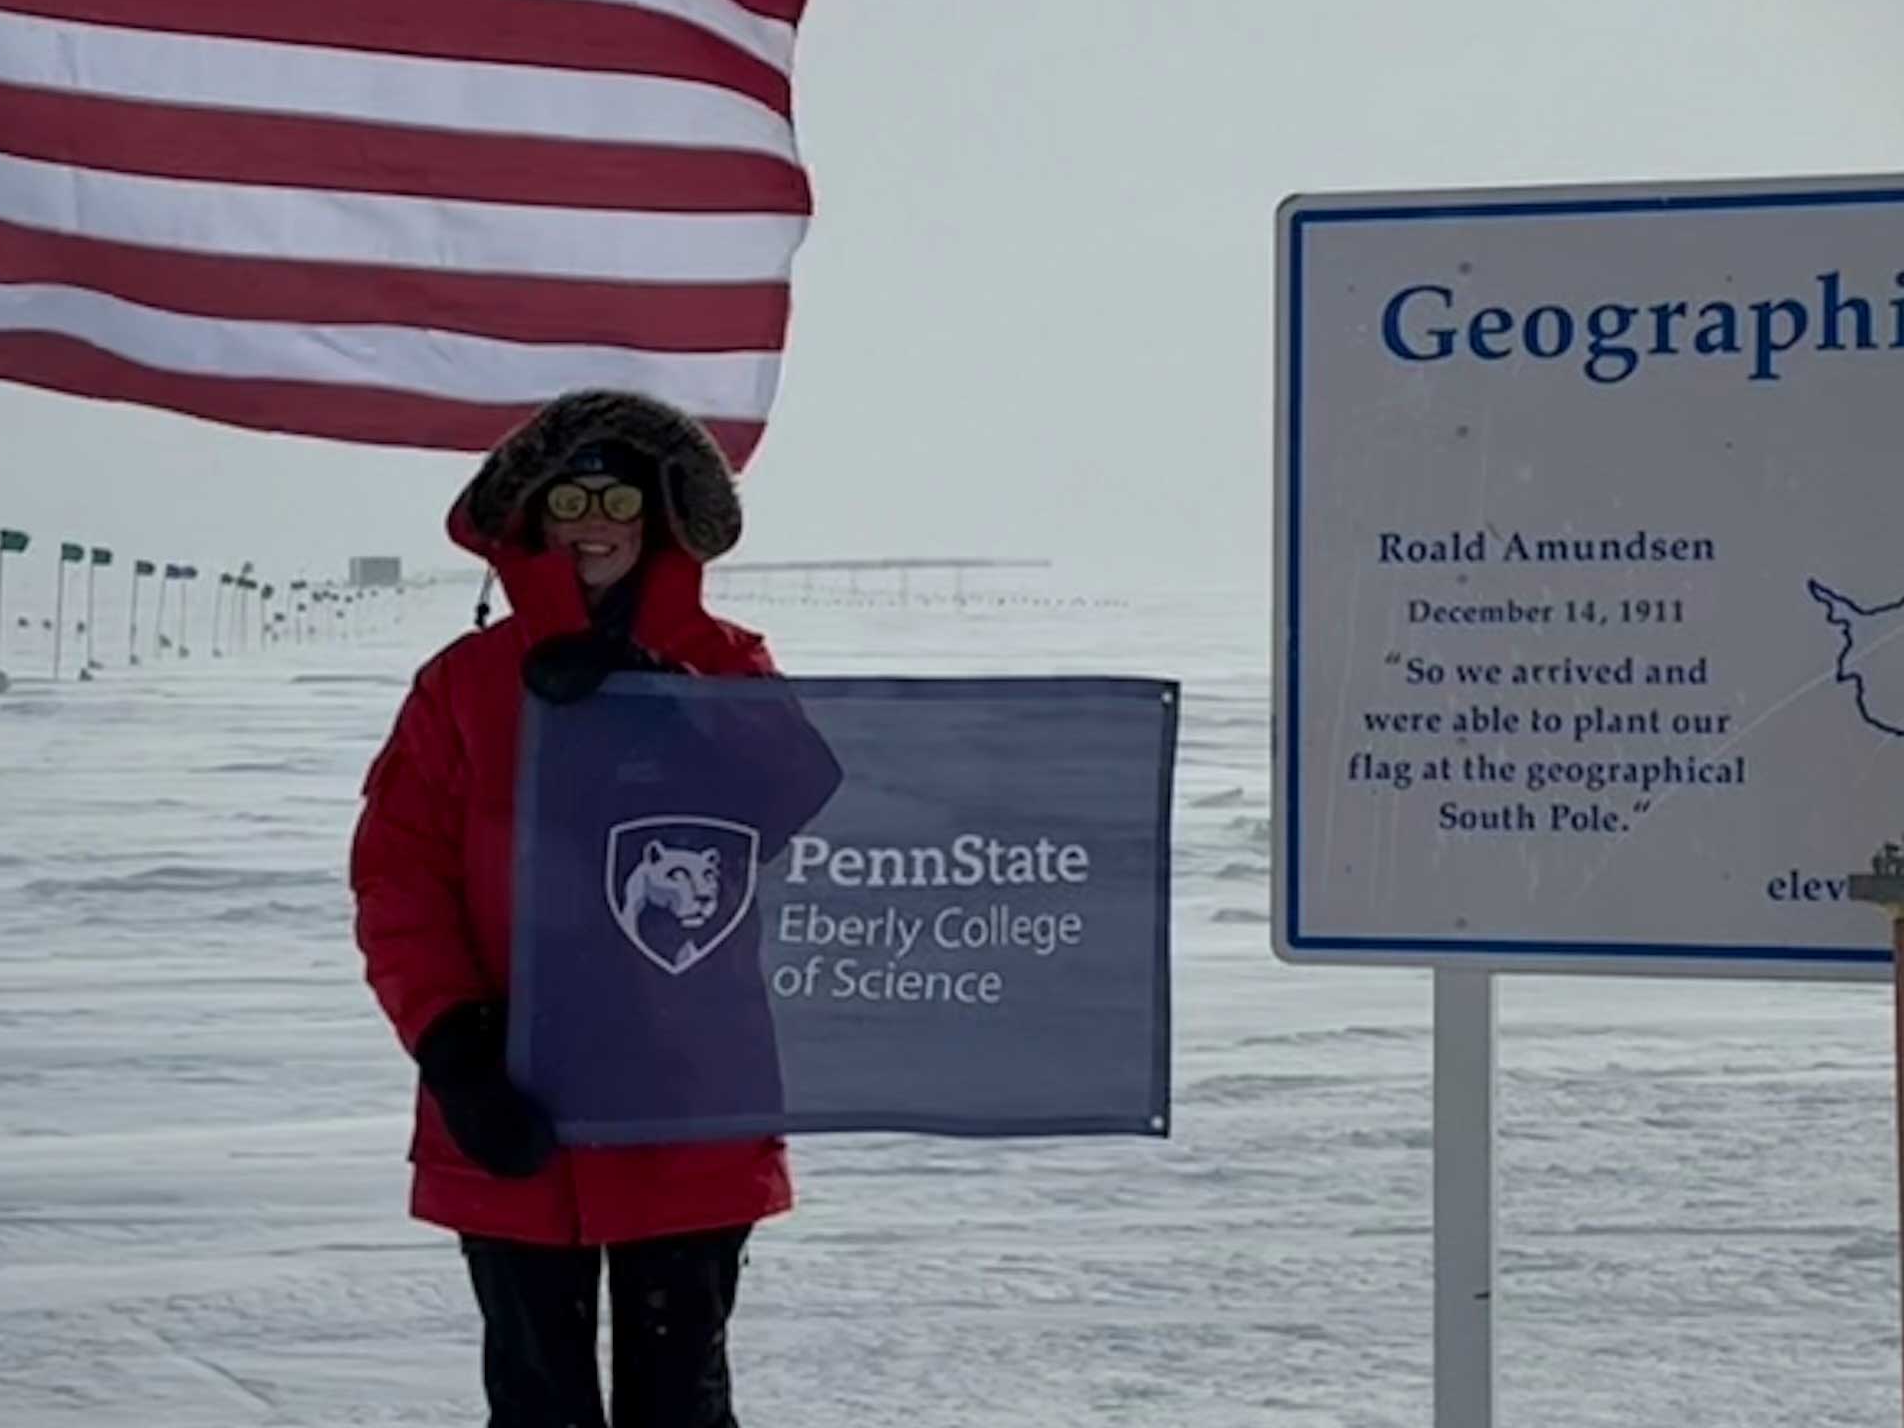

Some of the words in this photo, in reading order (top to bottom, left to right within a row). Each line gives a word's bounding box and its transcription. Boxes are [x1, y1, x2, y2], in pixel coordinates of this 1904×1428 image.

[1378, 531, 1486, 563] Roald
[1503, 531, 1716, 562] Amundsen
[1408, 598, 1553, 625] December
[1565, 599, 1609, 626] 14,
[1620, 599, 1684, 623] 1911
[1456, 661, 1502, 685] we
[1511, 657, 1633, 685] arrived
[1645, 657, 1708, 685] and
[1363, 711, 1442, 734] were
[1452, 705, 1520, 734] able
[1531, 710, 1562, 734] to
[1573, 706, 1660, 743] plant
[1672, 711, 1732, 735] our
[1347, 752, 1413, 790] flag
[1422, 757, 1452, 781] at
[1463, 753, 1517, 783] the
[1525, 756, 1746, 793] geographical
[1438, 801, 1536, 832] South
[784, 832, 1090, 888] PennState
[778, 903, 924, 960] Eberly
[932, 903, 1084, 956] College
[772, 955, 825, 998] of
[831, 957, 1004, 1004] Science
